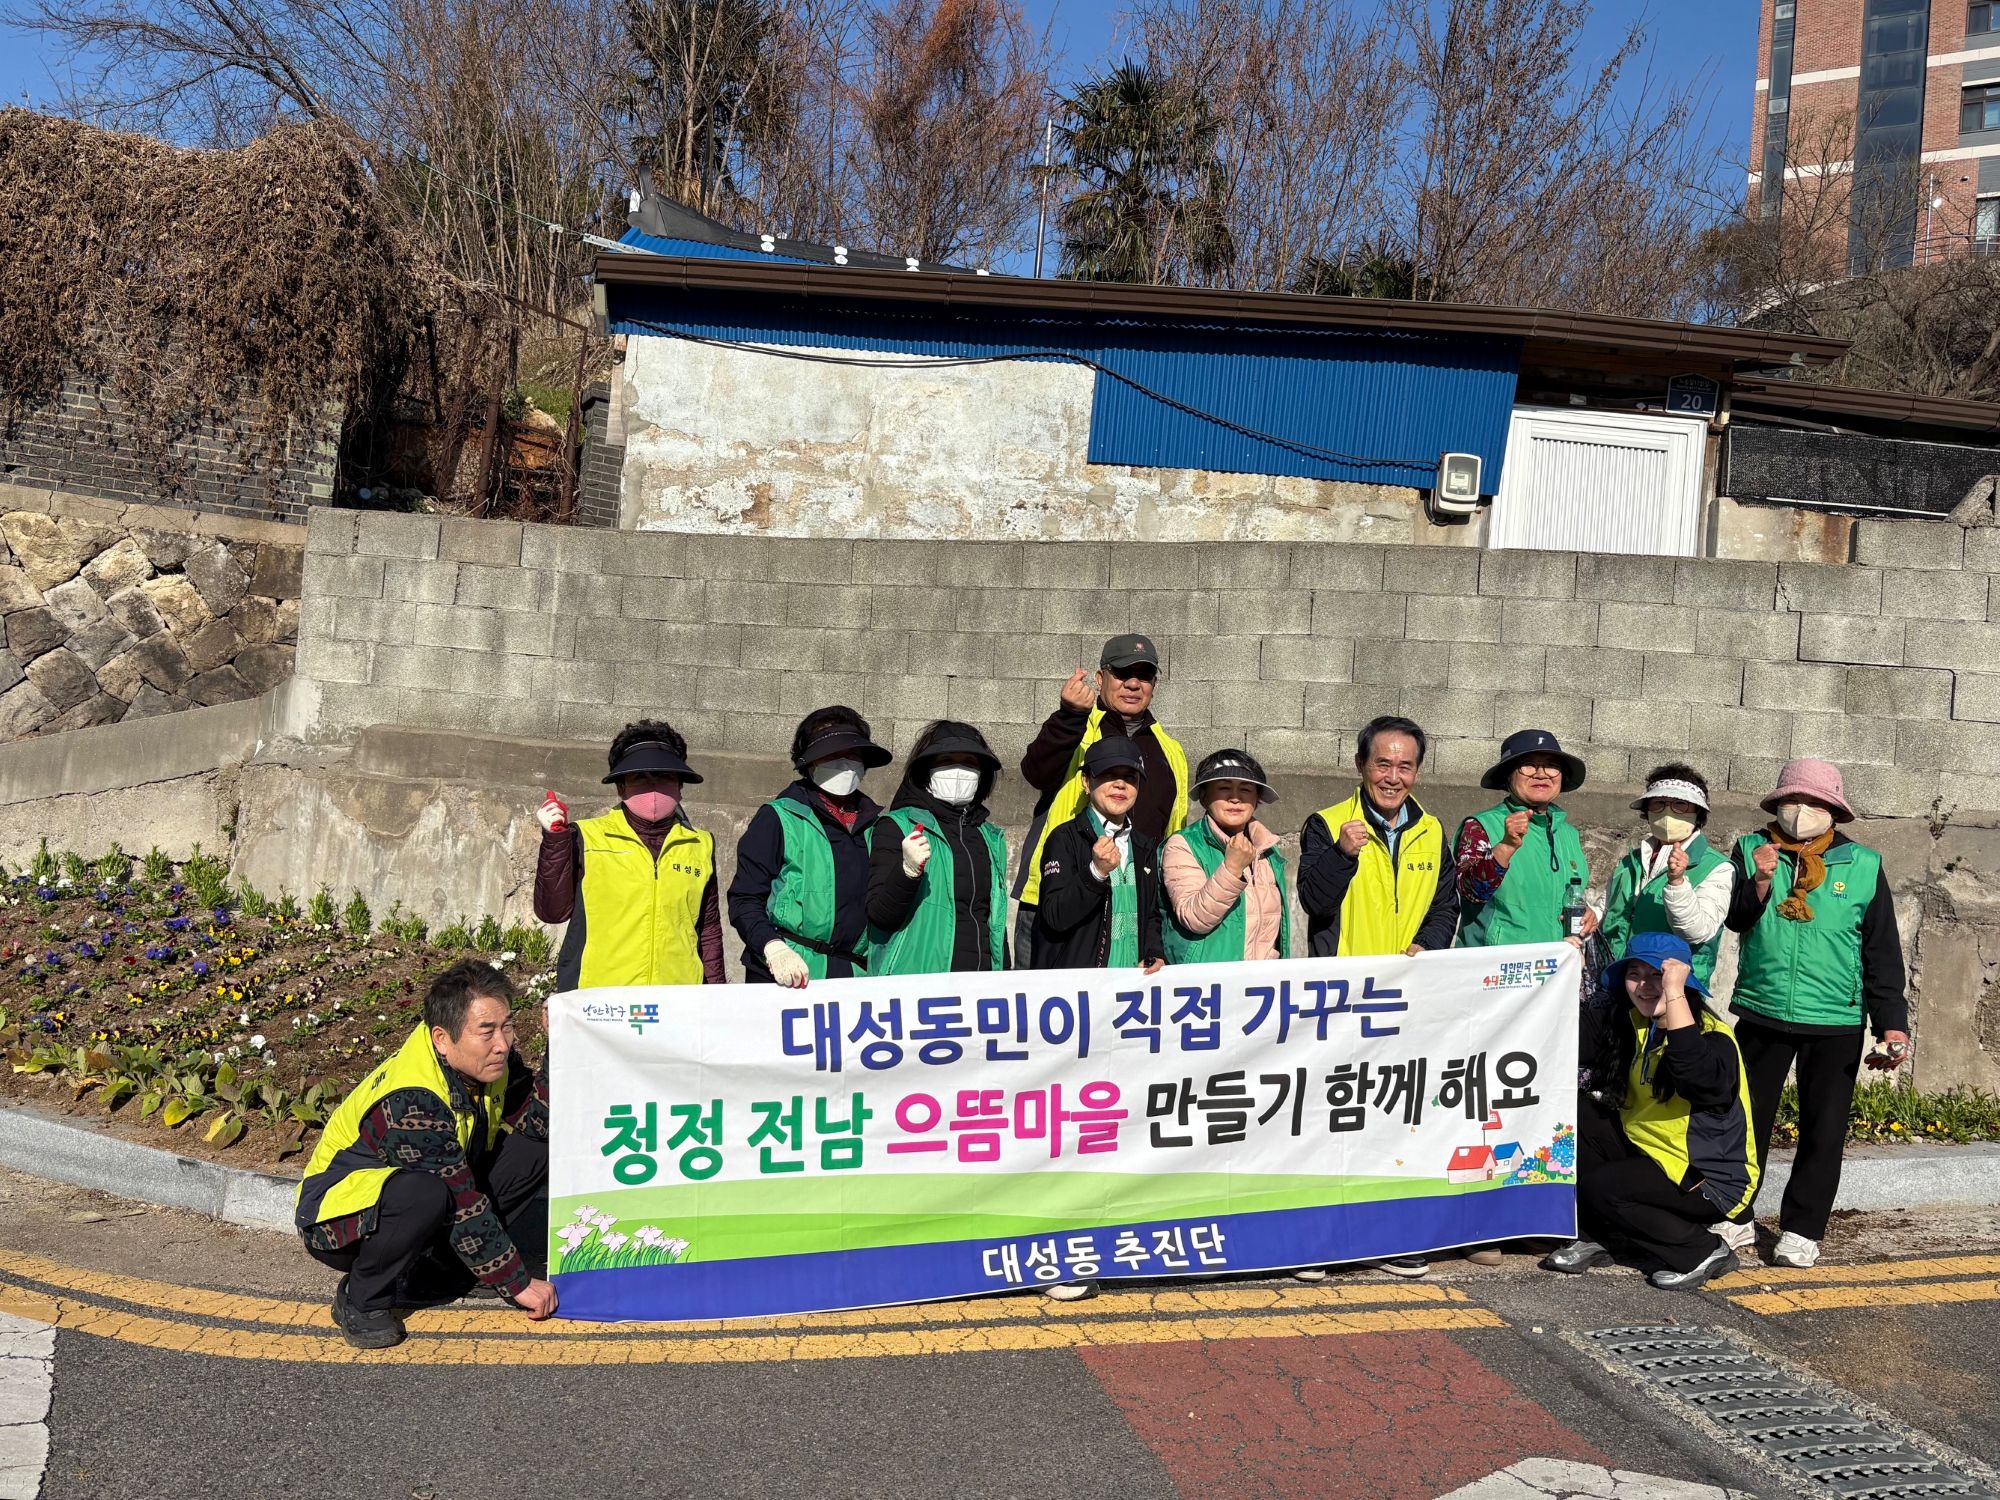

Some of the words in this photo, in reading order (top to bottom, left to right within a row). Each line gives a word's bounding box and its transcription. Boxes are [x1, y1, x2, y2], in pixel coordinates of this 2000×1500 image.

[1680, 393, 1702, 410] 20
[672, 863, 701, 877] 대성동
[1500, 961, 1532, 974] 대한민국
[1533, 958, 1558, 986] 목포
[628, 1004, 660, 1036] 목포
[781, 990, 1090, 1072] 대성동민이
[1113, 983, 1222, 1054] 직접
[1242, 977, 1408, 1044] 가꾸는
[601, 1099, 723, 1185] 청정
[748, 1092, 873, 1173] 전남
[887, 1081, 1128, 1162] 으뜸마을
[1146, 1067, 1307, 1149] 만들기
[1324, 1057, 1427, 1132] 함께
[1439, 1051, 1540, 1122] 해요
[982, 1233, 1101, 1284] 대성동
[1113, 1223, 1227, 1272] 추진단
